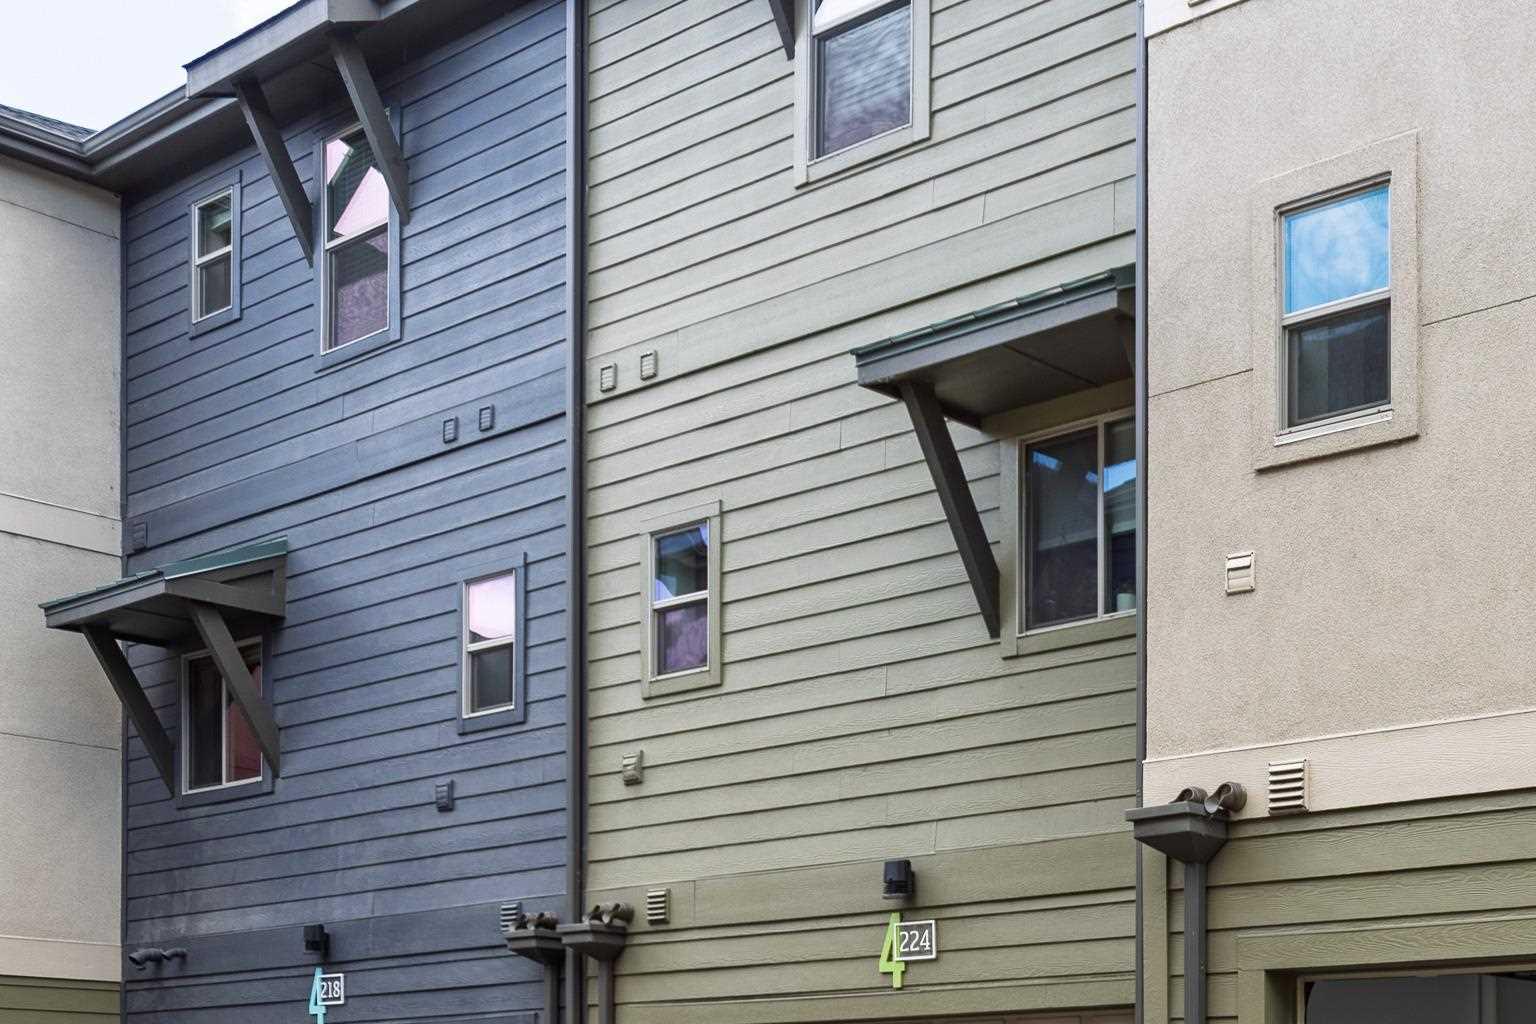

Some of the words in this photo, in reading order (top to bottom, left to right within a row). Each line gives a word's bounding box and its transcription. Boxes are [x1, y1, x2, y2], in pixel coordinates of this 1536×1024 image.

[879, 912, 905, 988] 4
[899, 929, 931, 952] 224
[320, 980, 341, 998] 218
